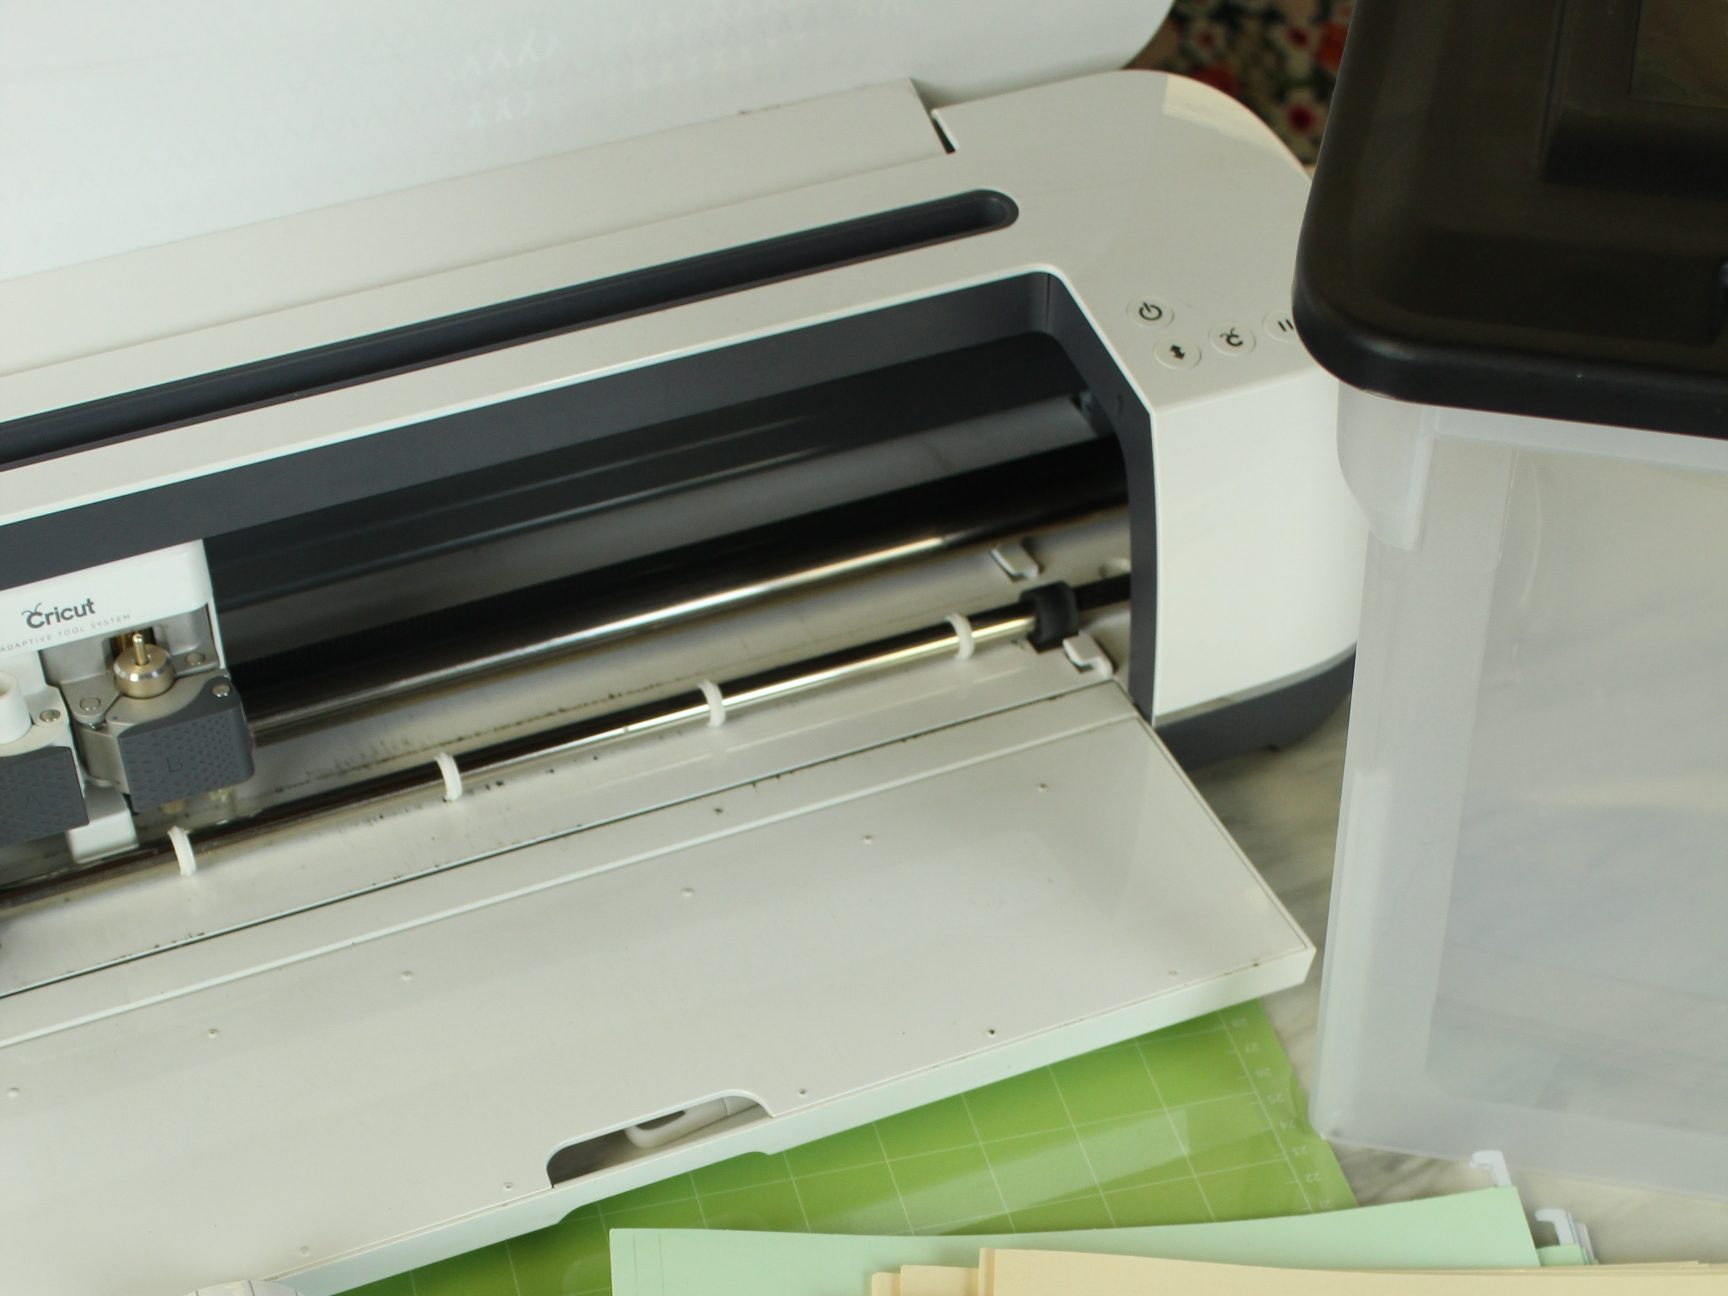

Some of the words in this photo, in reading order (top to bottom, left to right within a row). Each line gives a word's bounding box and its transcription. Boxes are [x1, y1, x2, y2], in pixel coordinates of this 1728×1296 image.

[21, 598, 95, 629] Cricut
[58, 626, 85, 637] TOOL
[90, 613, 130, 629] SYSTEM
[166, 755, 184, 773] B
